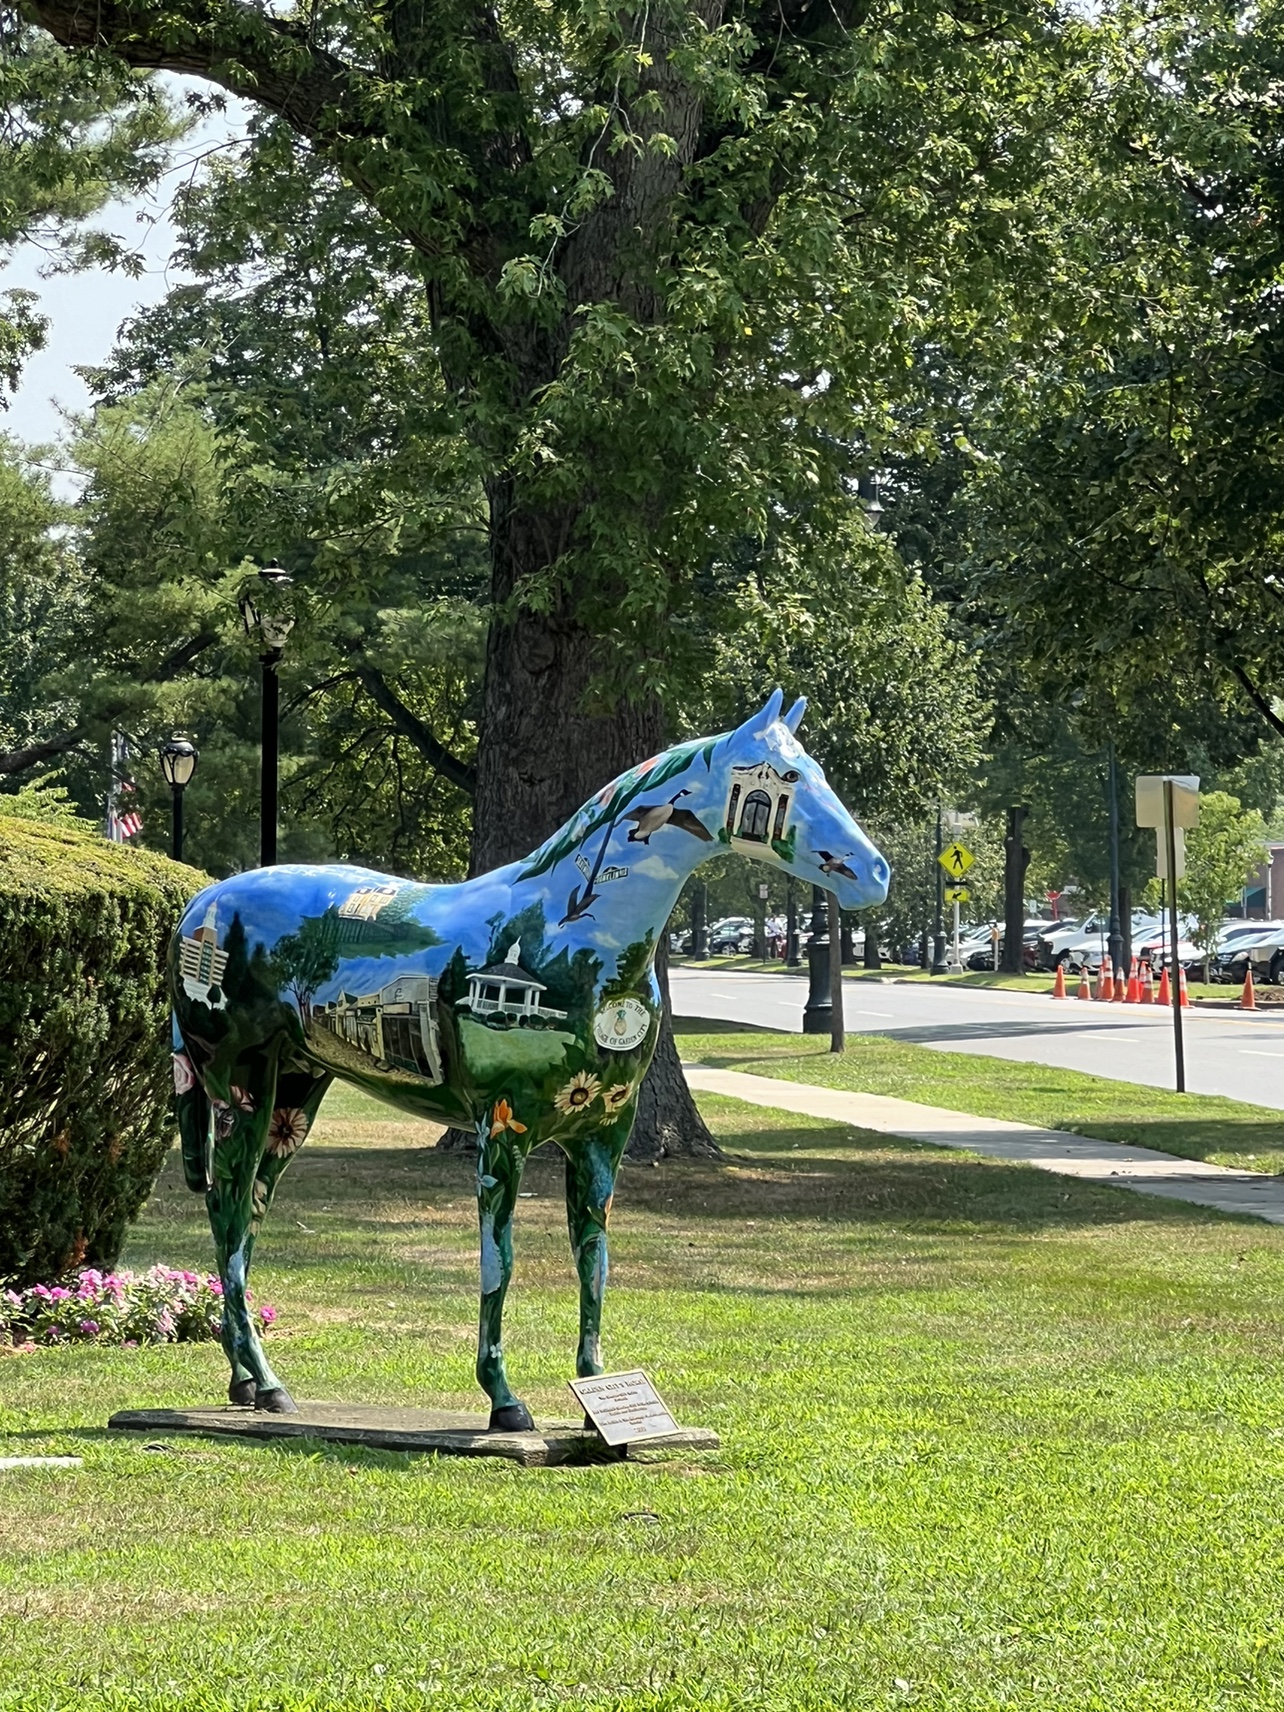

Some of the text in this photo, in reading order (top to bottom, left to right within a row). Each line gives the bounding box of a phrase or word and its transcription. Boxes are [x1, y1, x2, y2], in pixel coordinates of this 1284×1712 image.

[626, 1001, 633, 1009] TO
[634, 1004, 646, 1017] THE
[609, 1037, 617, 1045] OF
[618, 1035, 637, 1045] GARDEN
[637, 1023, 647, 1037] CITY
